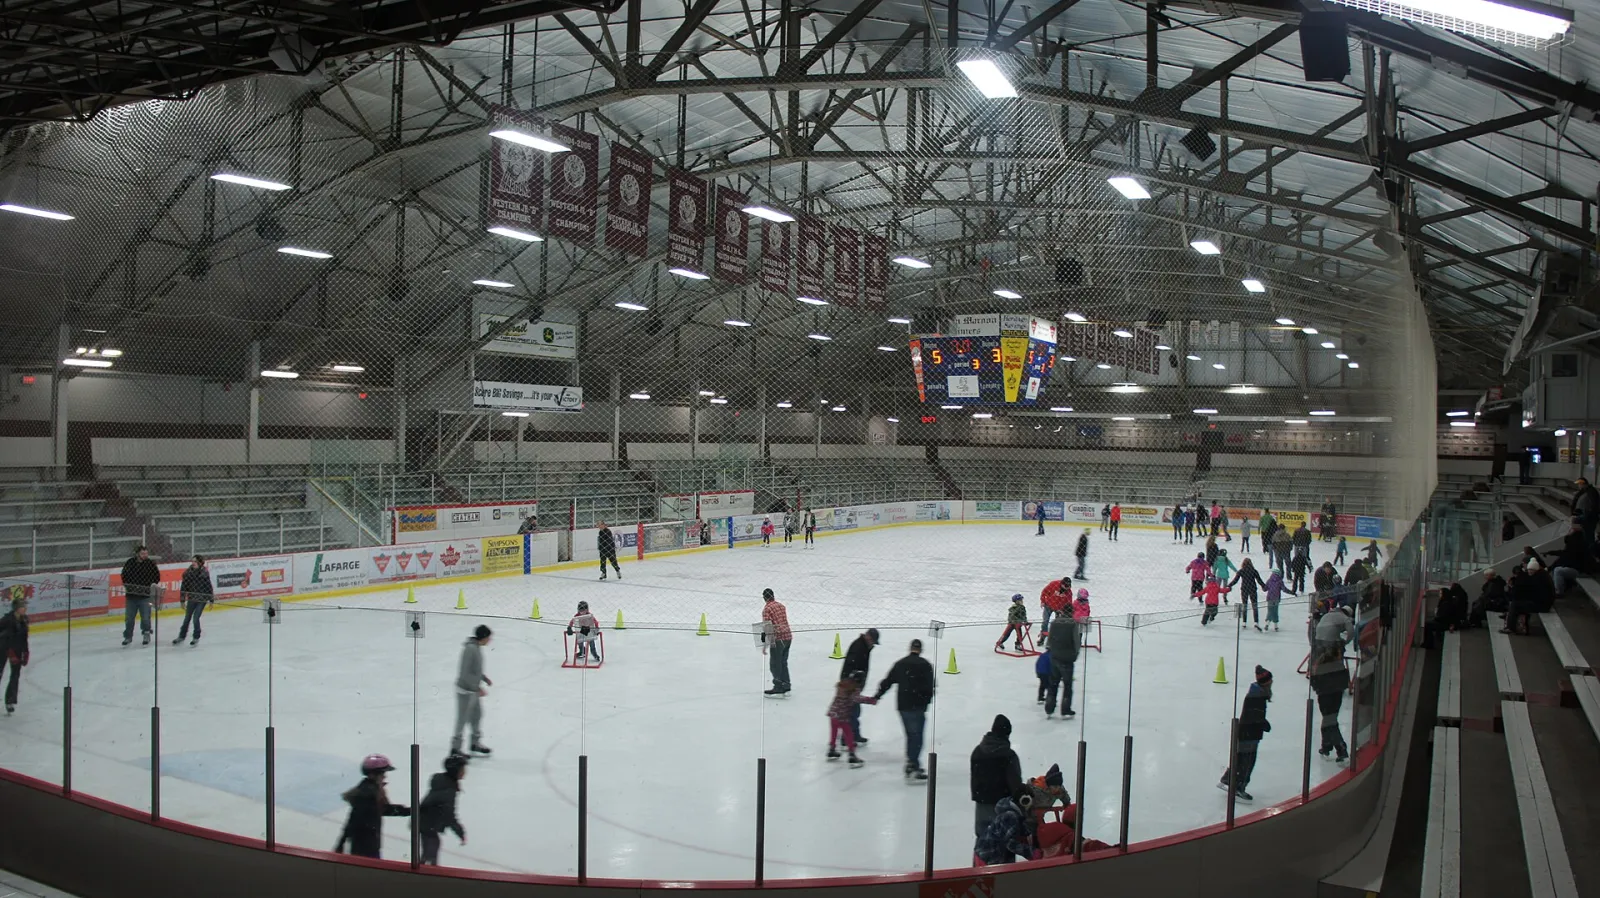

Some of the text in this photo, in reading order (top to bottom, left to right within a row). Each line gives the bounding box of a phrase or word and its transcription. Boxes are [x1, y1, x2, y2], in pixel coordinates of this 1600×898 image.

[493, 198, 519, 211] WESTERN
[497, 210, 532, 224] CHAMPIONS
[556, 218, 590, 232] CHAMPIONS
[931, 349, 942, 364] 5
[991, 347, 1001, 363] 3
[971, 358, 980, 370] 3
[1279, 511, 1304, 521] Home
[319, 560, 360, 573] LAFARGE
